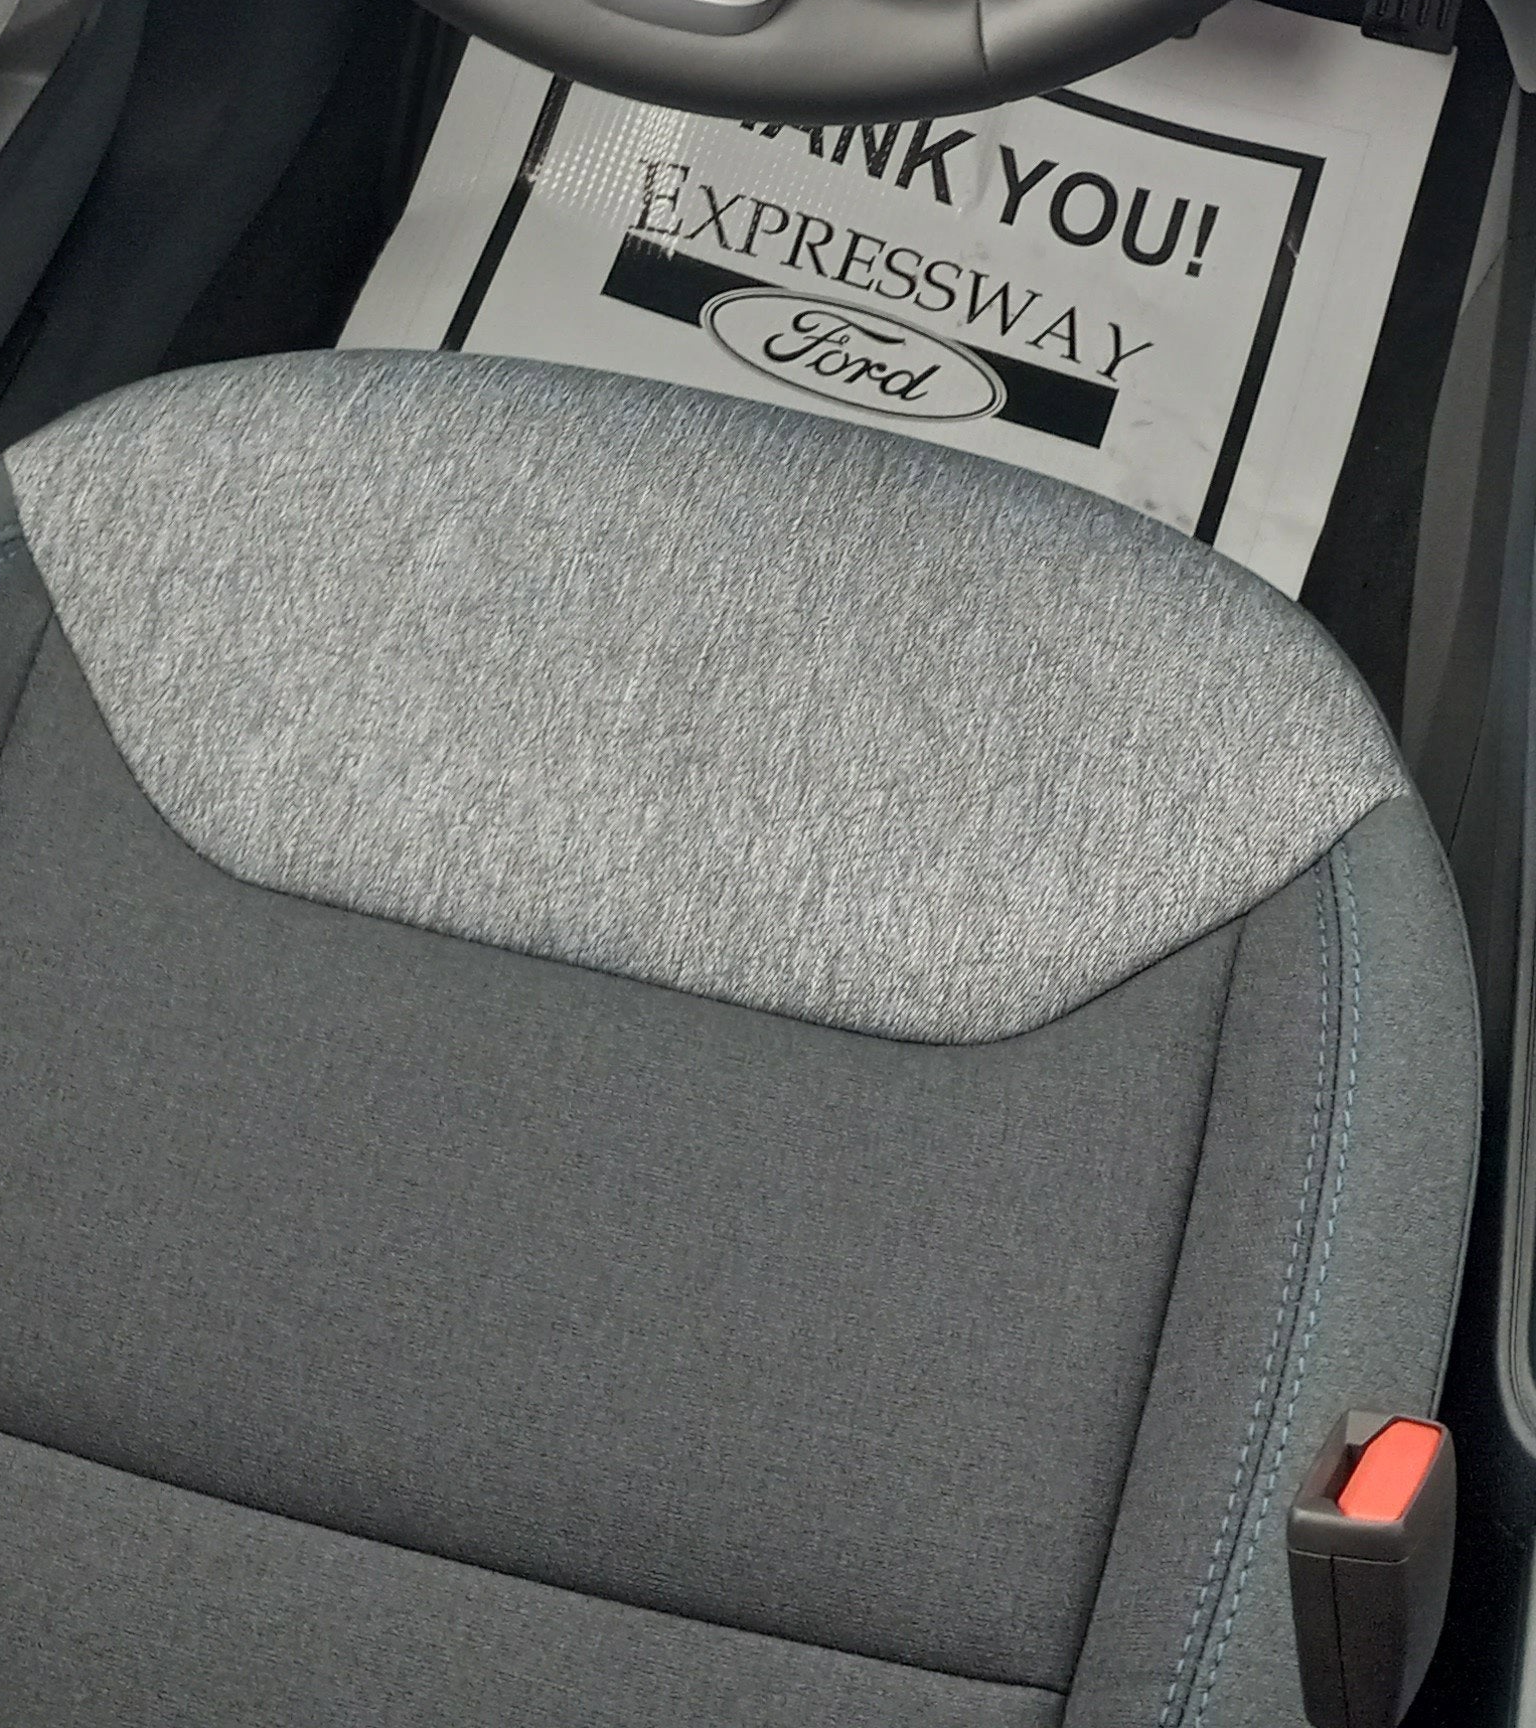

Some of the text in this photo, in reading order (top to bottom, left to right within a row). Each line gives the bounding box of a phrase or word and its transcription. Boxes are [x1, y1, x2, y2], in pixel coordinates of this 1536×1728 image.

[632, 158, 1155, 384] EXPRESSWAY
[997, 143, 1220, 279] YOU!
[762, 308, 943, 404] Ford
